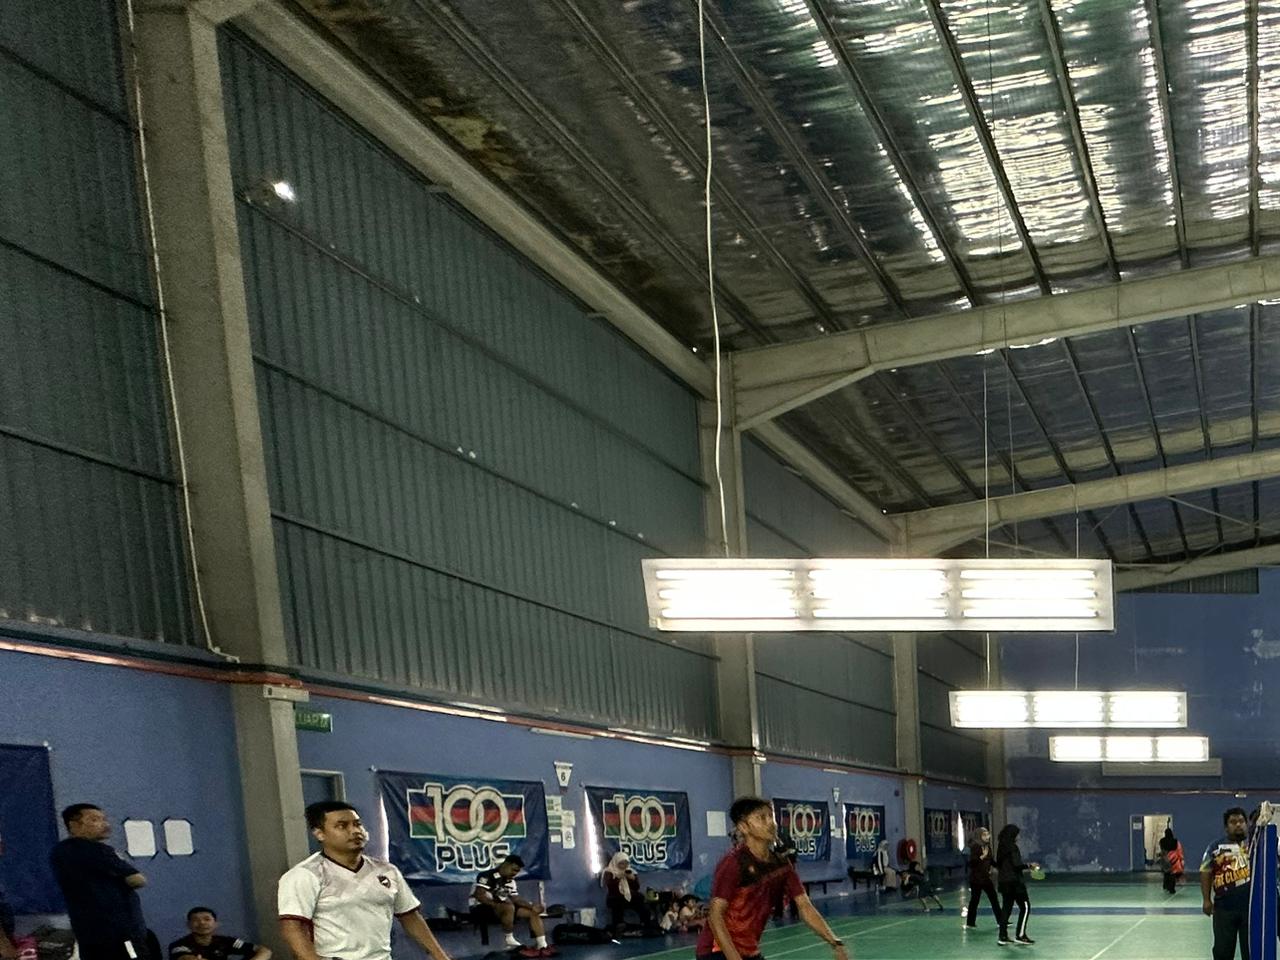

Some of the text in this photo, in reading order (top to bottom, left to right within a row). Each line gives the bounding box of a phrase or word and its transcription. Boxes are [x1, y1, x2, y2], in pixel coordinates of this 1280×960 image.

[424, 783, 509, 844] 100
[614, 794, 666, 841] 100
[786, 804, 816, 838] 100
[854, 807, 876, 837] 100
[791, 838, 816, 857] LUS
